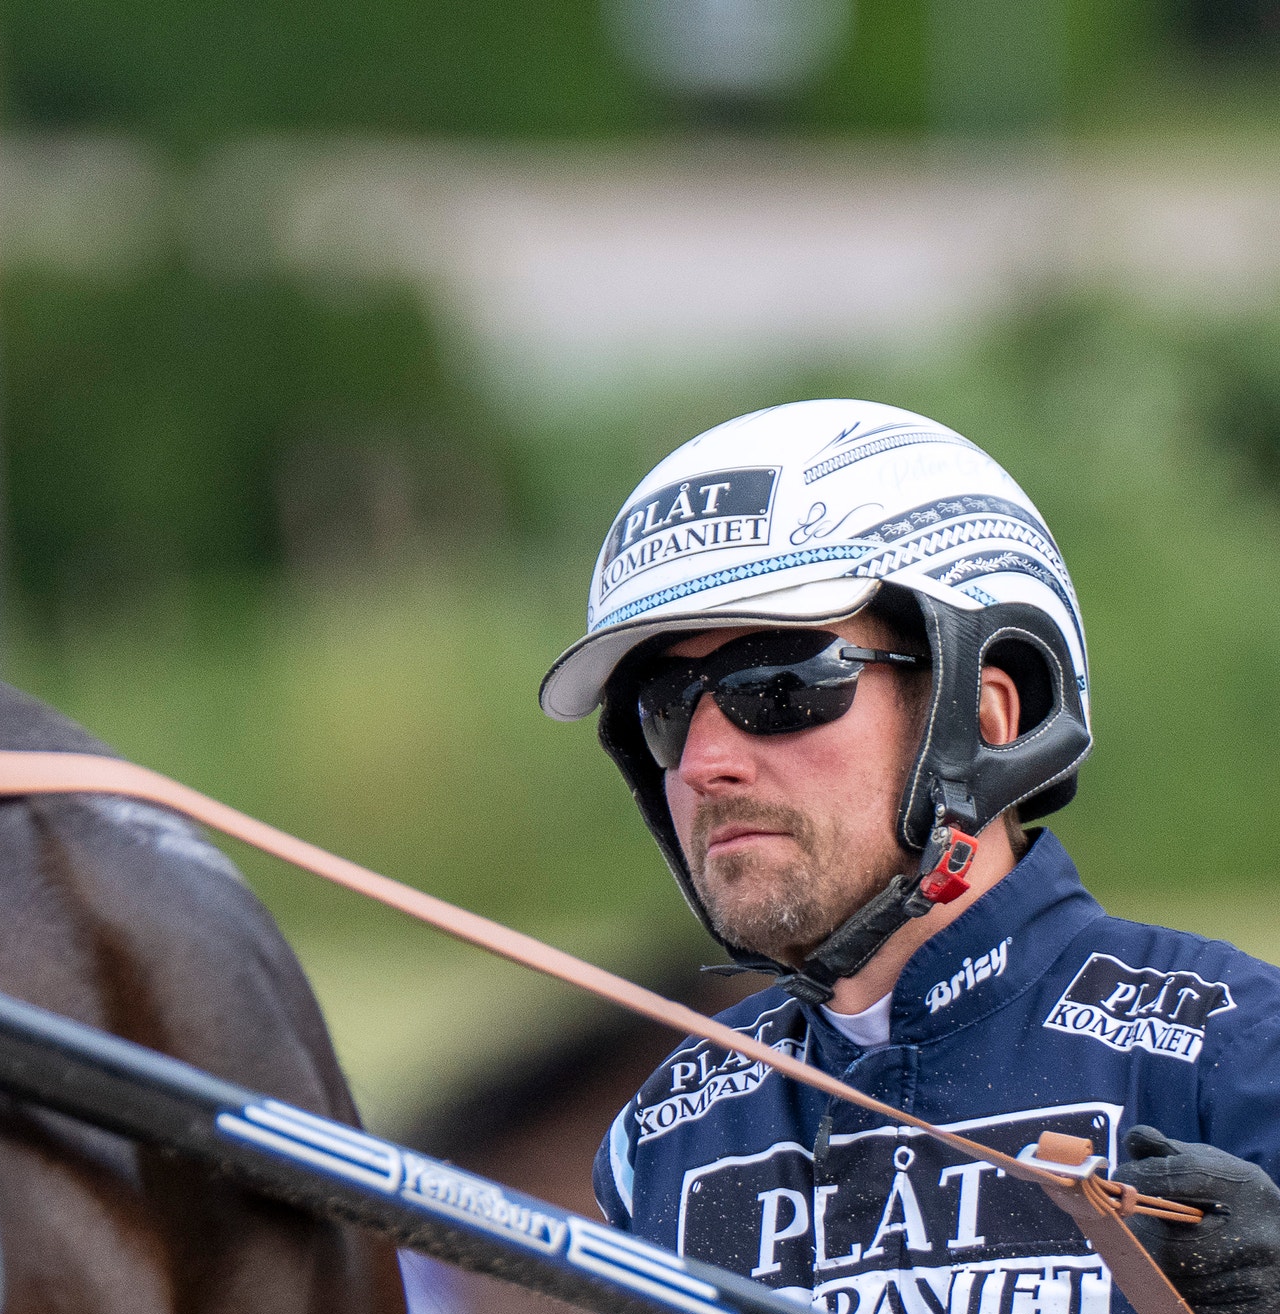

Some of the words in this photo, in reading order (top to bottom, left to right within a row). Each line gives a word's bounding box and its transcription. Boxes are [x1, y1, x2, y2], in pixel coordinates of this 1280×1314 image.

[621, 482, 731, 548] PLÅT
[600, 517, 767, 597] KOMPANIET
[751, 1146, 1006, 1278] PLÅT
